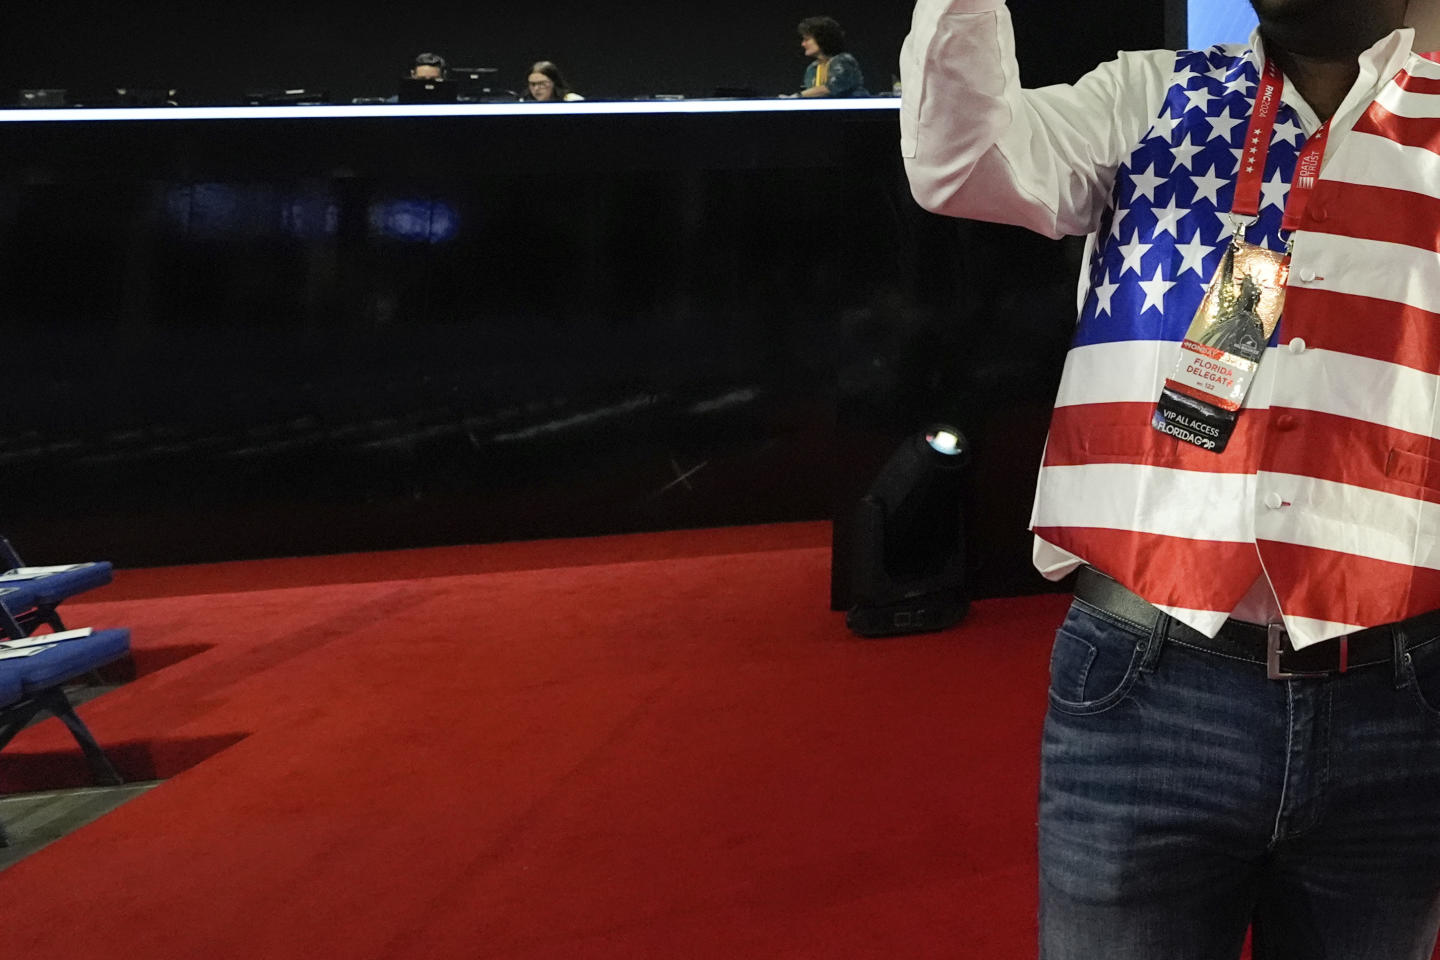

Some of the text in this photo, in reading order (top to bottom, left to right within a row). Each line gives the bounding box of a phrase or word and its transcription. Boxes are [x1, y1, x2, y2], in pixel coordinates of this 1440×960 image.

[1299, 155, 1311, 177] DATA
[1308, 151, 1320, 176] TRUST
[1186, 365, 1234, 388] DELEGATE
[1193, 357, 1233, 377] FLORIDA
[1163, 409, 1220, 438] VIP ALL ACCESS
